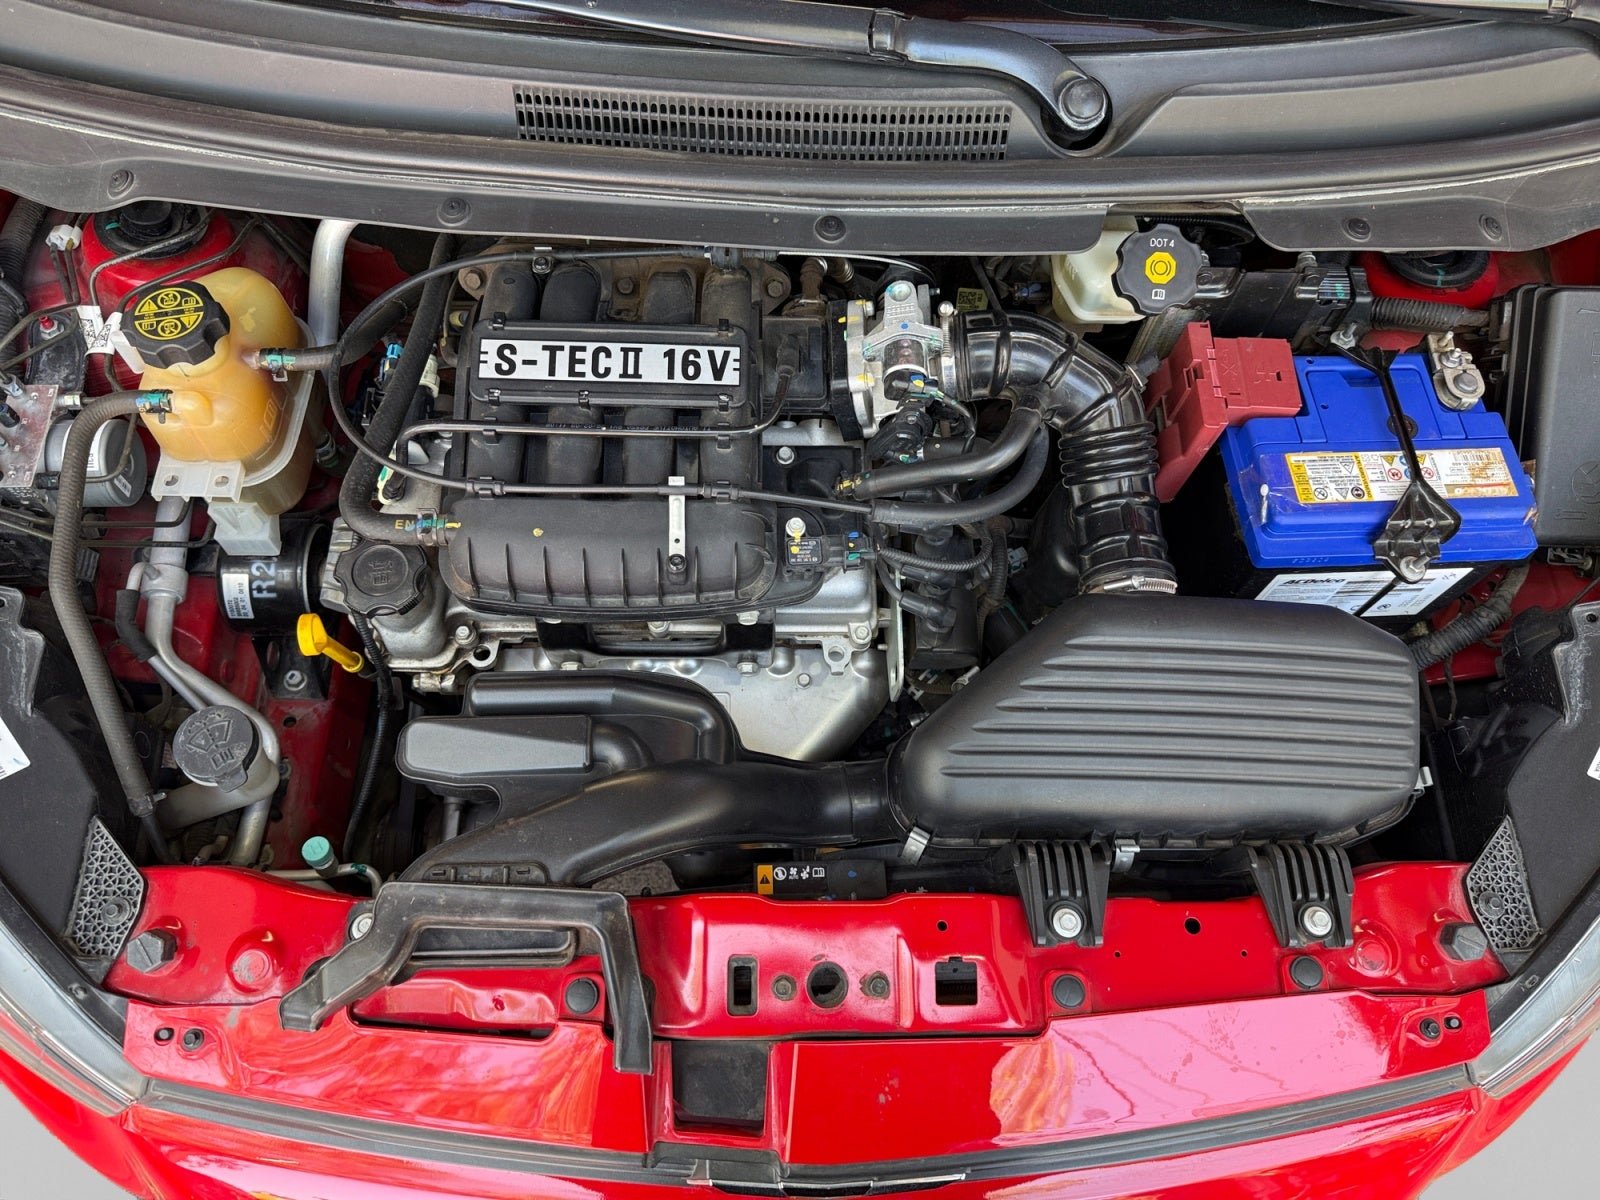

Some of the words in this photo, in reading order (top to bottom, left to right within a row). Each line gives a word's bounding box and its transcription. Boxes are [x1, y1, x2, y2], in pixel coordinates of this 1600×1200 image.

[1150, 238, 1168, 247] DOT
[1169, 239, 1175, 247] 4
[663, 348, 731, 382] 16V
[251, 562, 277, 598] R2
